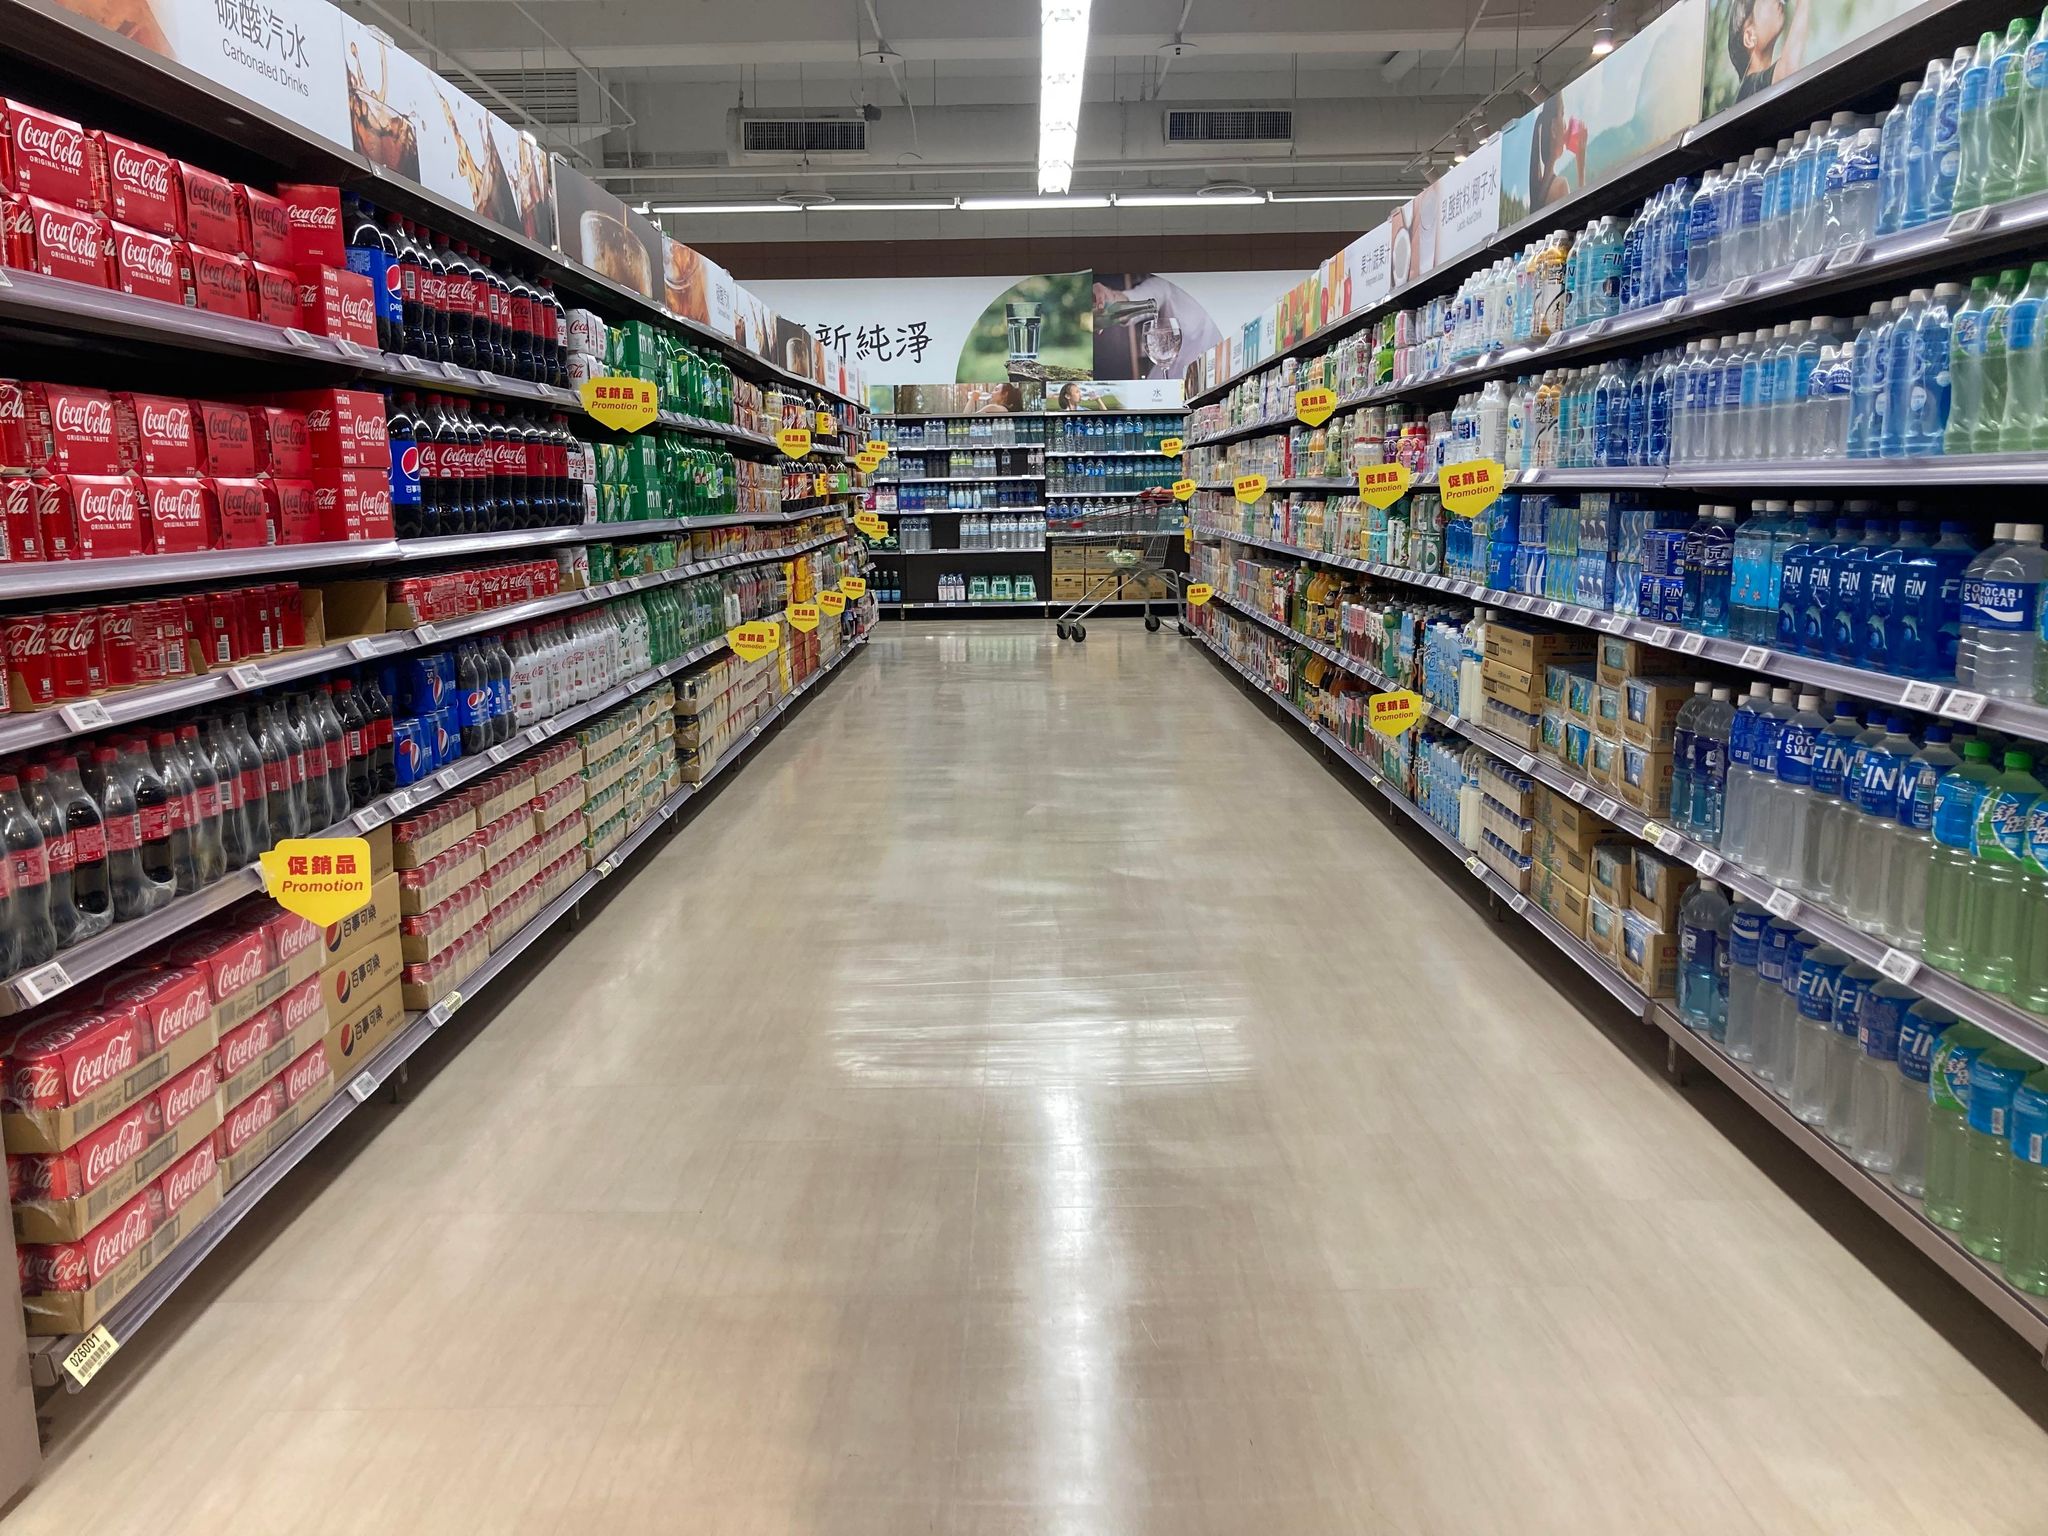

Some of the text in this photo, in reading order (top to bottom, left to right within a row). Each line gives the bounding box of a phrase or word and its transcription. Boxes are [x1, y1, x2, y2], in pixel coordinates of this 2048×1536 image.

[222, 38, 309, 97] Carbonated Drinks
[17, 117, 83, 167] Coca-Cola
[29, 155, 80, 176] ORIGINAL TASTE
[113, 148, 170, 194] Coca-Cola
[123, 183, 166, 202] ORIGINAL TASTE
[189, 175, 234, 217] Coca-Cola
[253, 199, 288, 235] Coca-Cola
[287, 204, 338, 226] Coca-Cola
[40, 212, 101, 258] Coca-Cola
[51, 251, 95, 267] ORIGINAL TASTE
[121, 235, 175, 278] Coca-Cola
[131, 270, 171, 285] ORIGINAL TASTE
[199, 256, 243, 294] Coca-Cola
[323, 271, 338, 282] mini
[324, 285, 339, 297] mini
[326, 300, 340, 312] mini
[342, 293, 374, 325] Coca-Cola
[327, 316, 341, 327] mini
[798, 322, 932, 364] 新純淨
[336, 395, 350, 406] mini
[596, 387, 634, 400] 促銷品
[338, 409, 352, 420] mini
[591, 401, 638, 411] Promotion
[1299, 405, 1331, 415] Promotion
[55, 397, 112, 435] Coca-Cola
[142, 405, 190, 440] Coca-Cola
[209, 410, 250, 442] Coca-Cola
[340, 424, 354, 435] mini
[355, 415, 387, 441] Coca-Cola
[66, 434, 109, 443] ORIGINAL TASTE
[152, 439, 174, 447] ORIGINAL
[342, 439, 355, 450] mini
[343, 453, 356, 464] mini
[342, 472, 356, 483] mini
[1366, 471, 1399, 484] 促銷品
[1448, 469, 1490, 488] 促銷品
[344, 487, 358, 498] mini
[1363, 484, 1402, 494] Promotion
[1446, 484, 1495, 500] Promotion
[80, 487, 134, 523] Coca-Cola
[154, 488, 201, 522] Coca-Cola
[223, 488, 262, 517] Coca-Cola
[346, 501, 359, 513] mini
[360, 490, 390, 518] Coca-Cola
[91, 522, 132, 531] ORIGINAL TASTE
[163, 520, 199, 529] ORIGINAL TASTE
[347, 516, 360, 527] mini
[1673, 540, 1685, 551] FI
[1783, 566, 1803, 584] FIN
[1809, 568, 1830, 587] FIN
[1839, 571, 1860, 591] FIN
[1871, 574, 1896, 594] FIN
[1641, 583, 1651, 592] FI
[1664, 587, 1683, 598] FIN
[1904, 579, 1926, 596] FIN
[1981, 587, 2023, 598] POCARI
[1980, 596, 2017, 608] SWEAT
[1376, 699, 1410, 713] 促銷品
[1374, 711, 1414, 722] Promotion
[288, 855, 356, 875] 促銷品
[282, 880, 363, 893] Promotion
[280, 918, 317, 960] Coca-Cola
[218, 944, 262, 999] Coca-Cola
[286, 983, 321, 1030] Coca-Cola
[1839, 989, 1860, 1013] FI
[157, 985, 206, 1045] Coca-Cola
[227, 1019, 269, 1073] Coca-Cola
[72, 1029, 133, 1098] Coca-Cola
[290, 1048, 325, 1098] Coca-Cola
[166, 1063, 212, 1126] Coca-Cola
[230, 1091, 272, 1149] Coca-Cola
[87, 1113, 143, 1186] Coca-Cola
[169, 1147, 214, 1211] Coca-Cola
[93, 1205, 146, 1278] Coca-Cola
[69, 1332, 101, 1367] 026001
